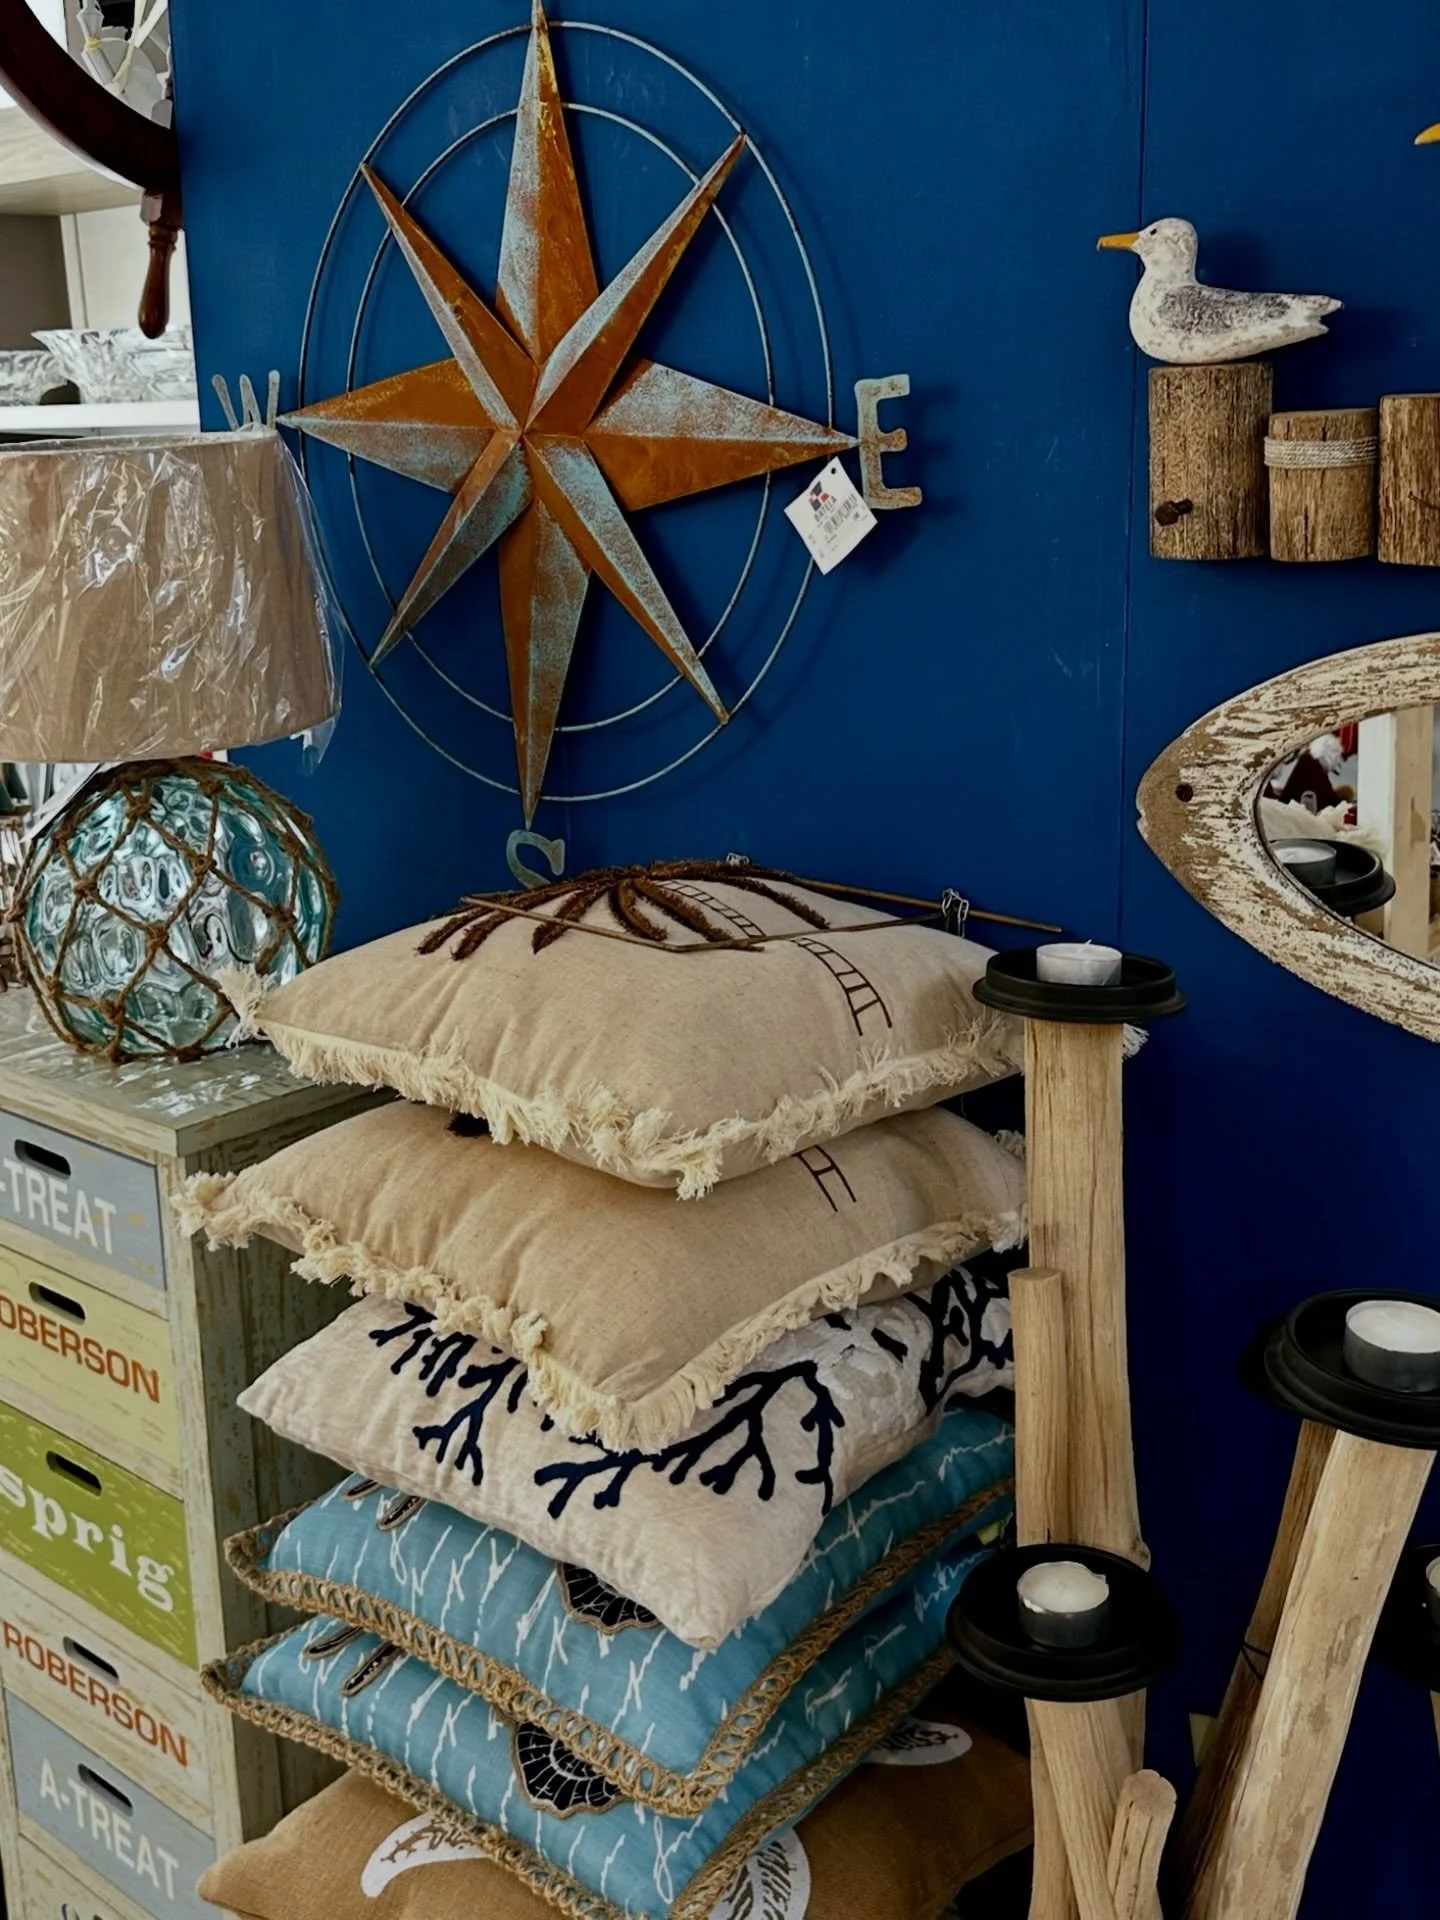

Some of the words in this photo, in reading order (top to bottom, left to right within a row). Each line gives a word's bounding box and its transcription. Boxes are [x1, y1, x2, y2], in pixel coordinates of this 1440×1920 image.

[854, 373, 923, 510] E
[0, 1464, 174, 1613] sprig
[2, 1620, 189, 1768] ROBERSON
[39, 1757, 179, 1900] A-TREAT
